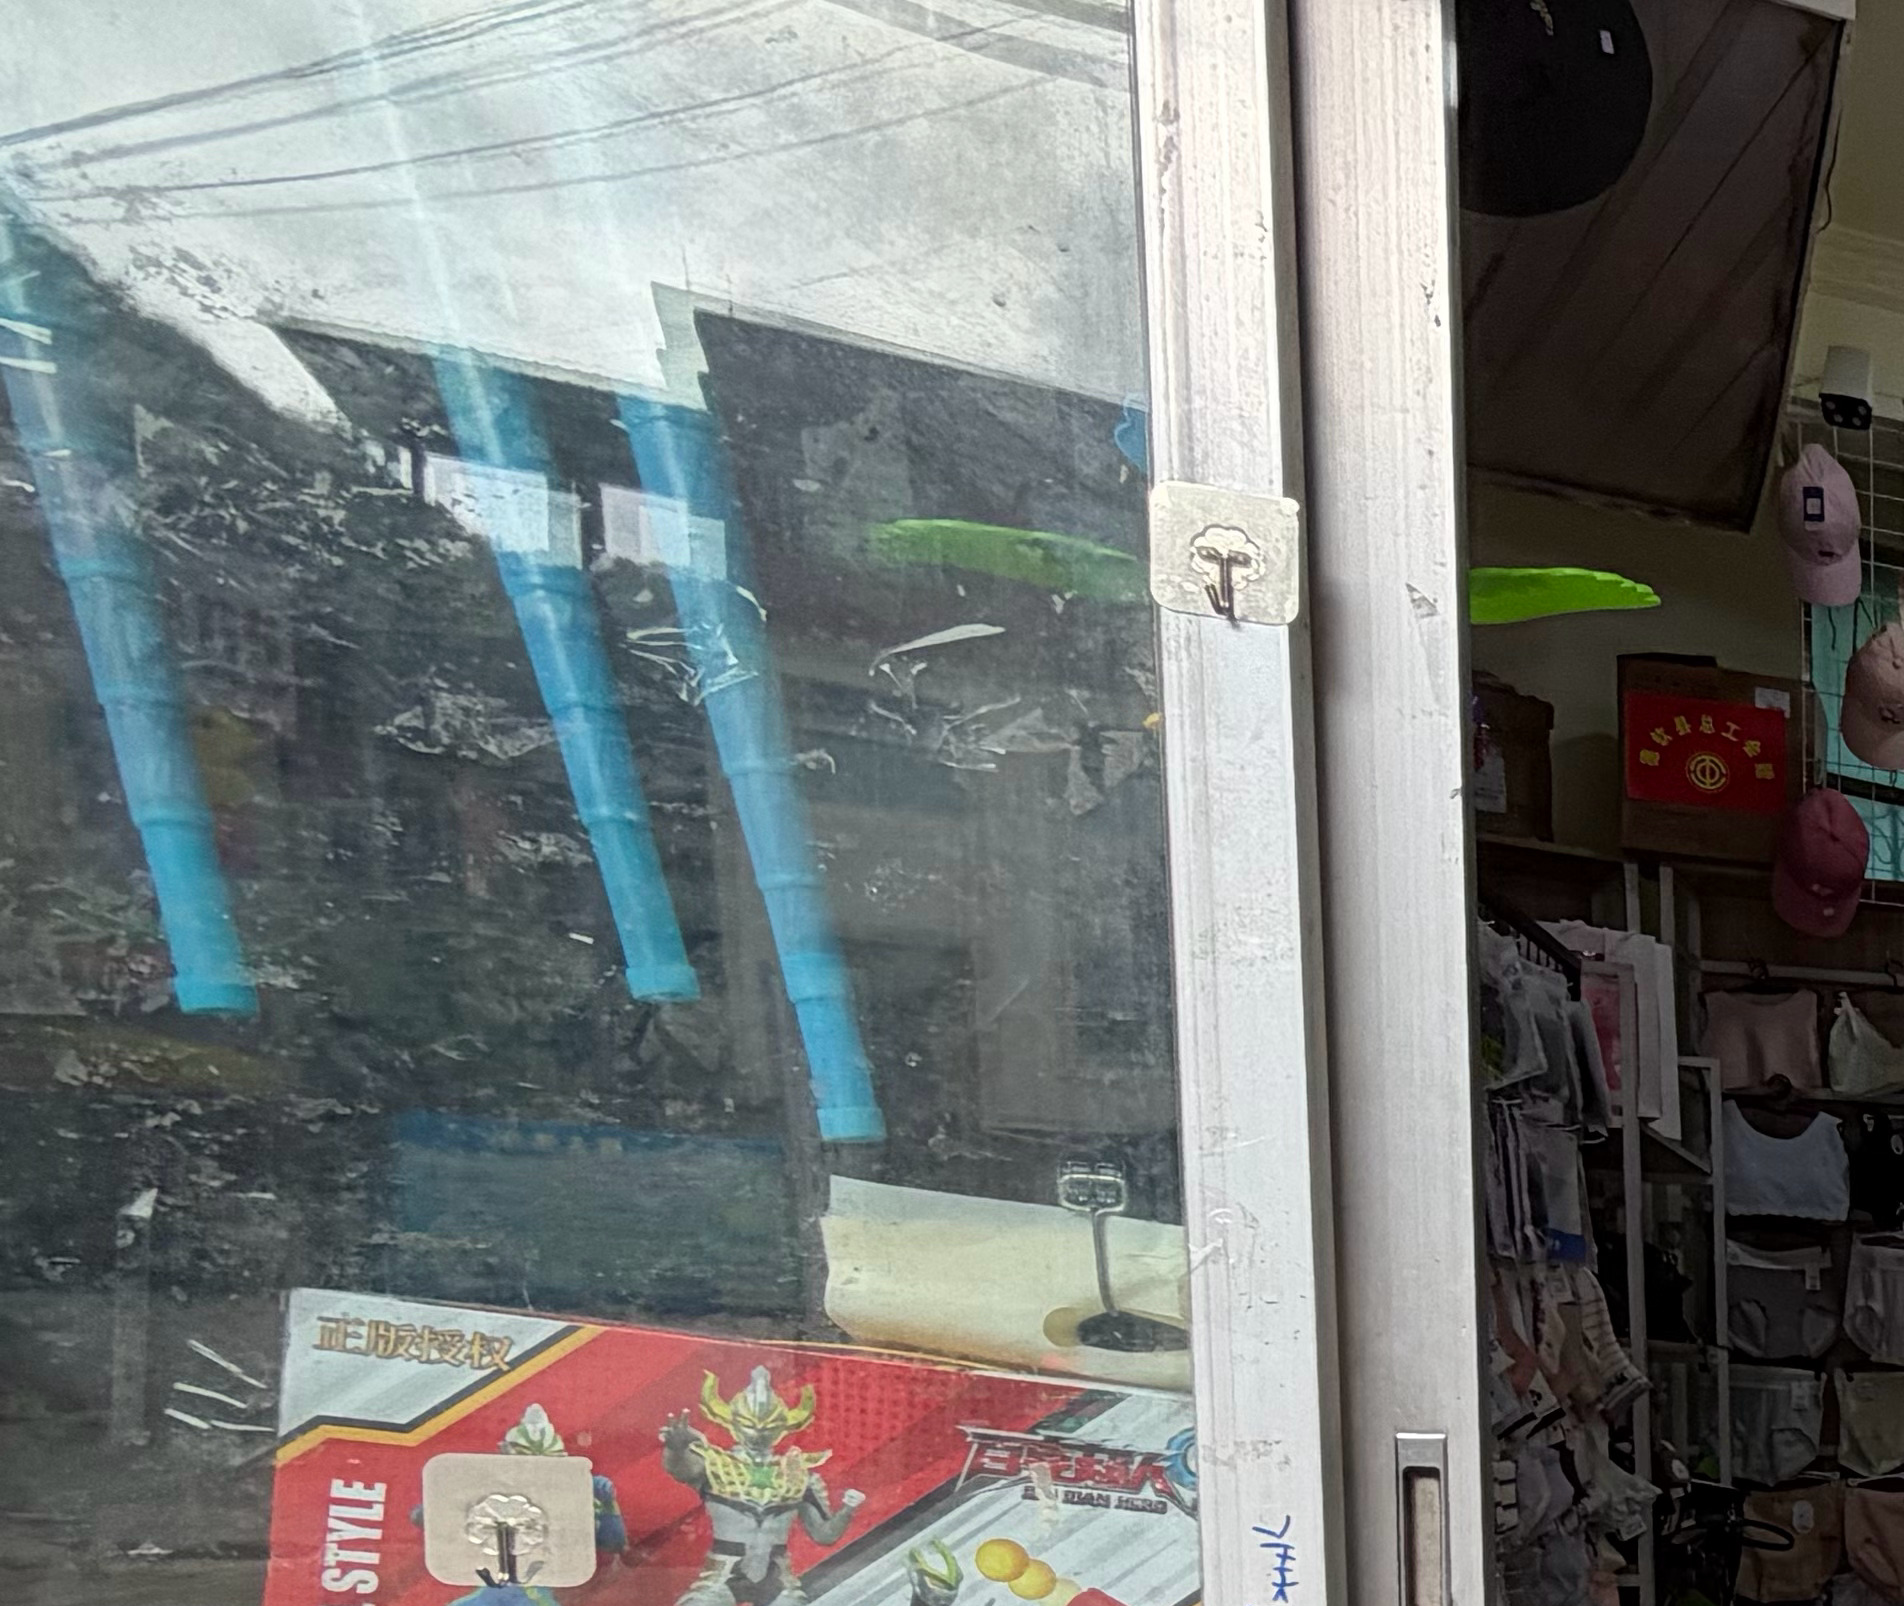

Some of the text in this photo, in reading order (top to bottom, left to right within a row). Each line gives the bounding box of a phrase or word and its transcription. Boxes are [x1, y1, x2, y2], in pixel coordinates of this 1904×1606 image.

[315, 1313, 514, 1372] 正版授权
[322, 1479, 388, 1600] STYLE
